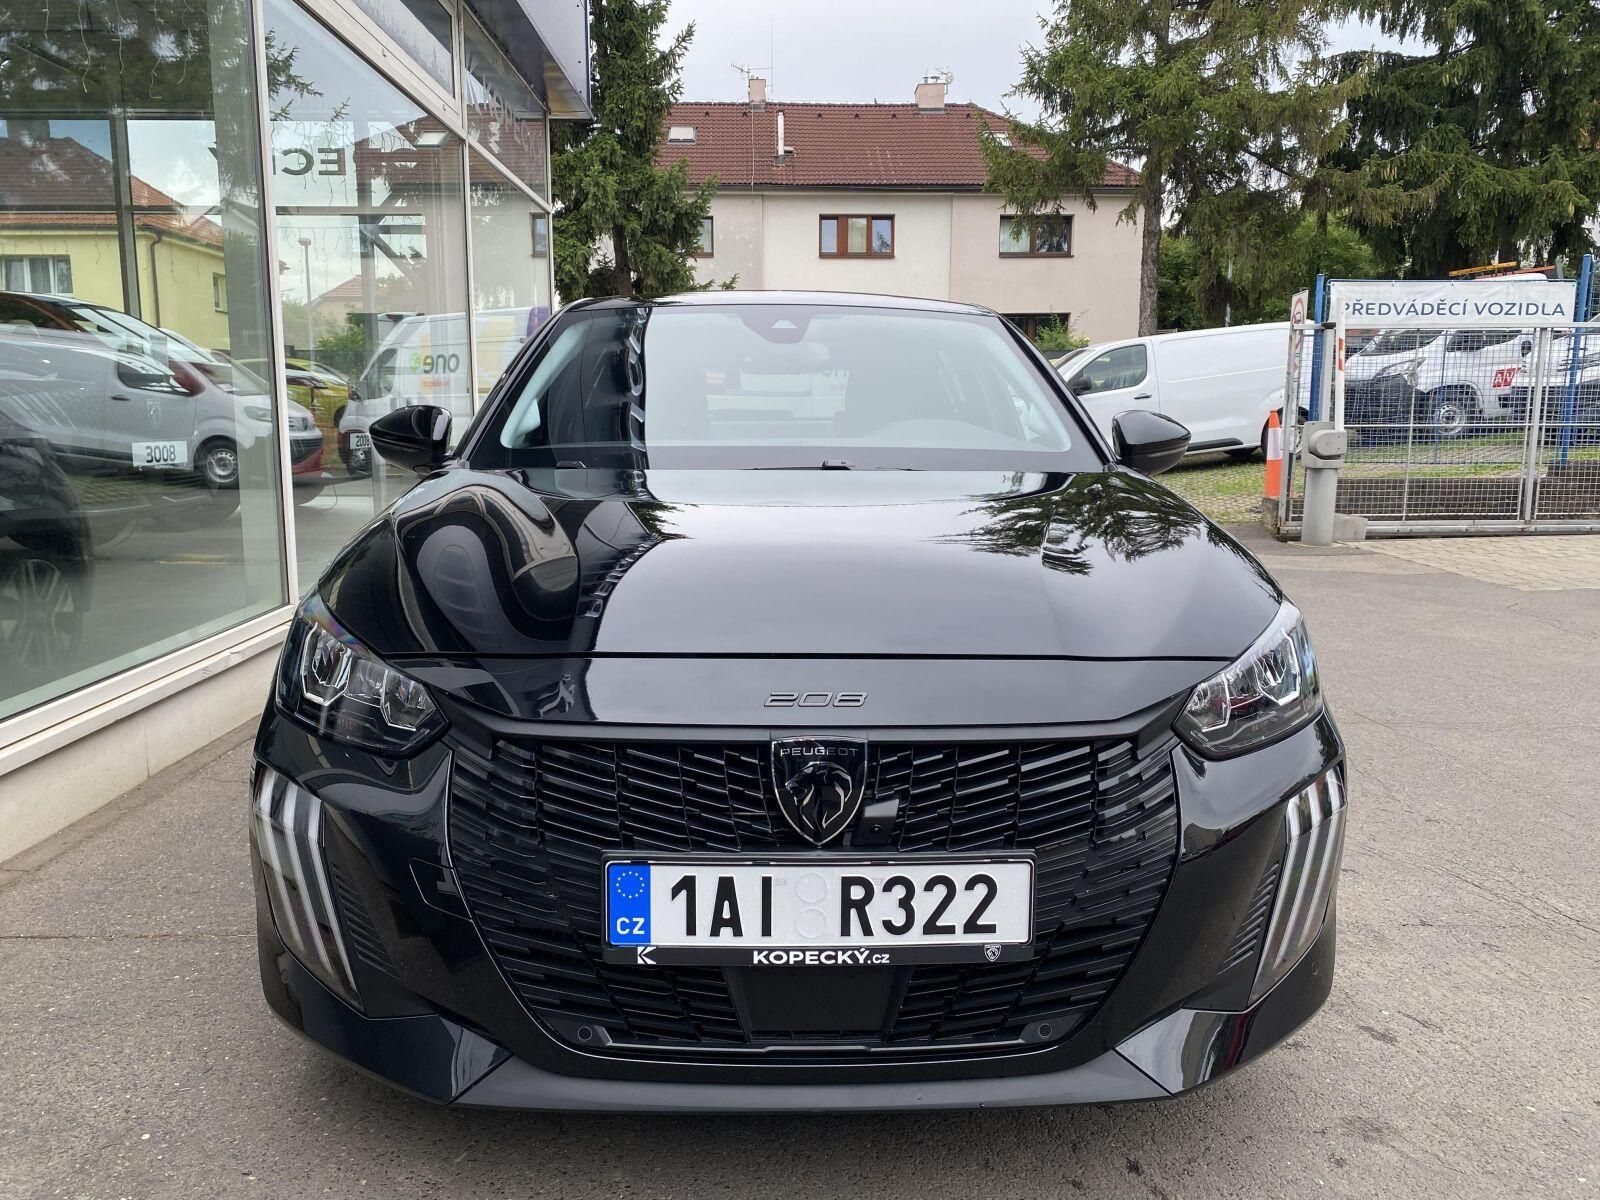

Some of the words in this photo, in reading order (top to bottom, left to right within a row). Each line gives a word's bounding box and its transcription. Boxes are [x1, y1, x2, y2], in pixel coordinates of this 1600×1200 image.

[1474, 302, 1565, 316] VOZIDLA
[145, 445, 176, 463] 3008
[763, 690, 868, 708] 208
[780, 747, 859, 757] PEUGEOT
[671, 875, 773, 937] 1AI
[840, 873, 998, 937] R322
[616, 917, 645, 935] CZ
